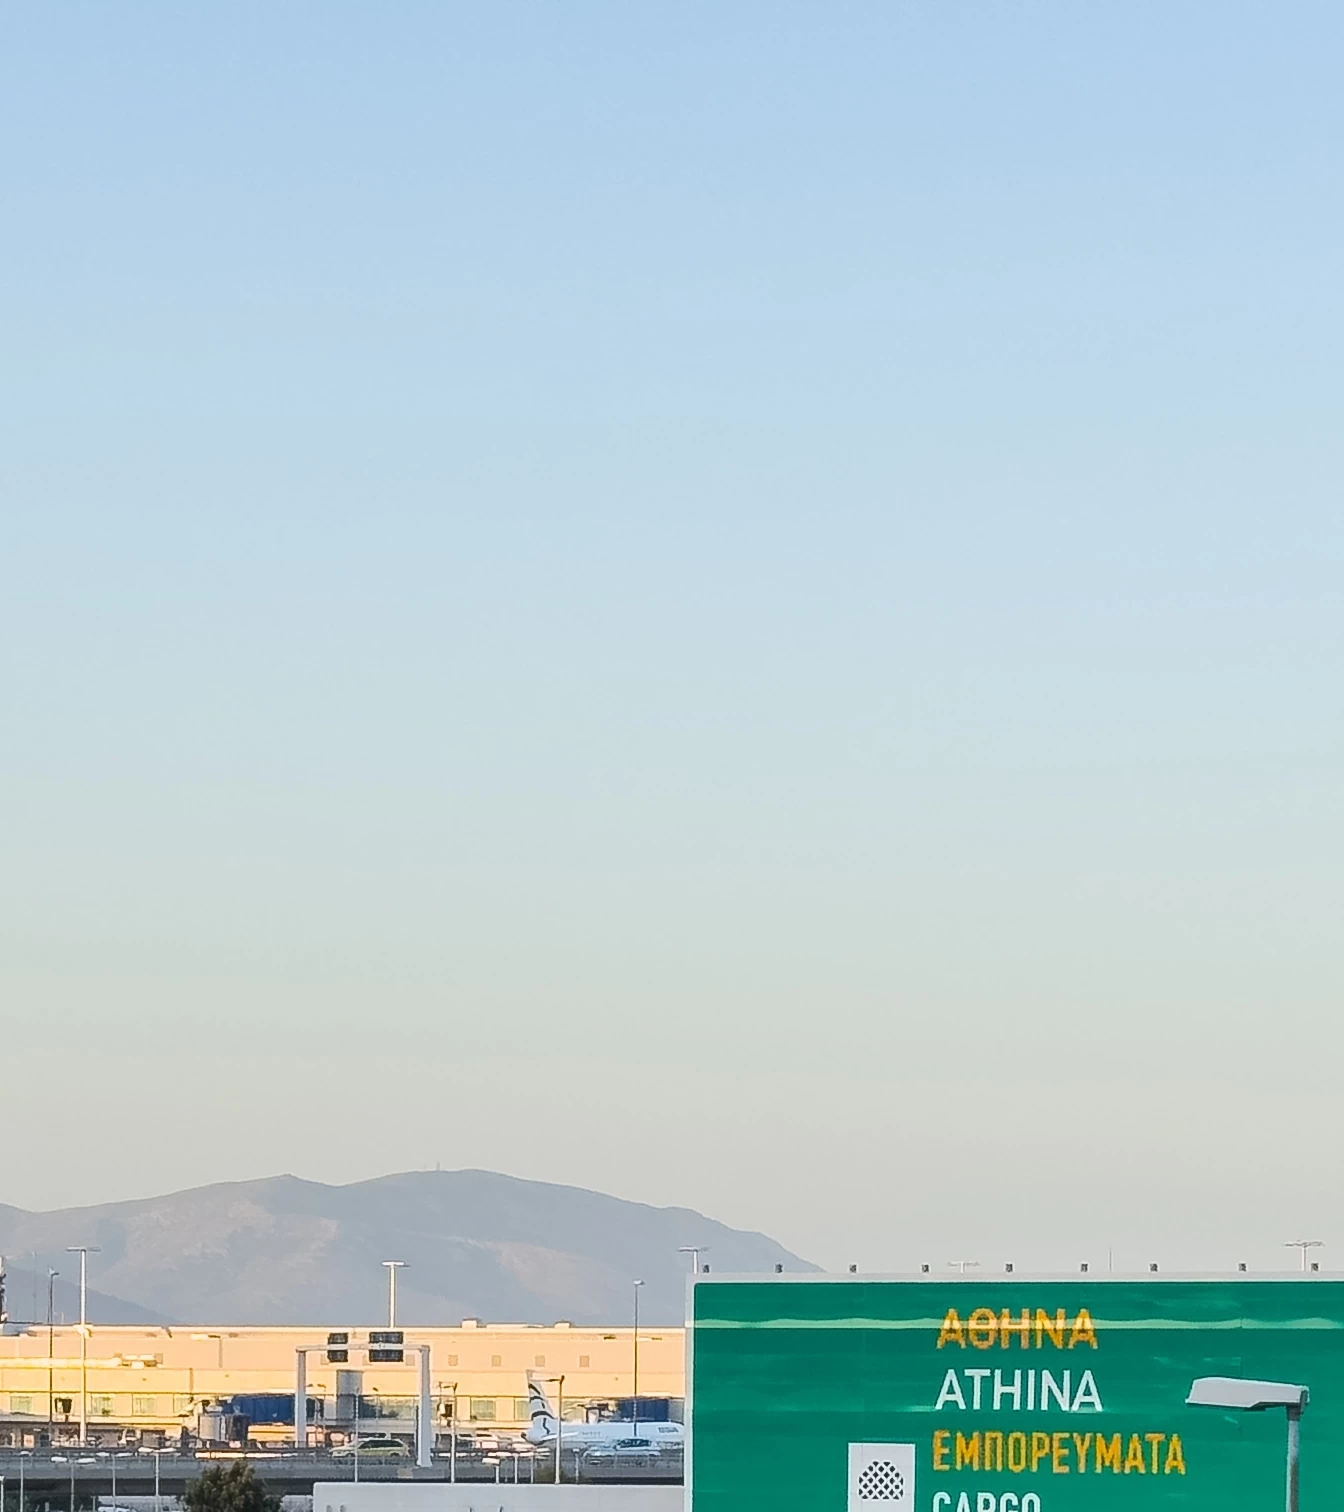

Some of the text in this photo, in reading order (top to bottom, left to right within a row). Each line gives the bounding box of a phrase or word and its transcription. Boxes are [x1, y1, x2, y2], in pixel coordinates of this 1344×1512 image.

[937, 1308, 1098, 1350] ΑΘΗΝΑ
[935, 1368, 1103, 1412] ATHINA
[932, 1429, 1186, 1476] ΕΜΠΟΡΕΥΜΑΤΑ
